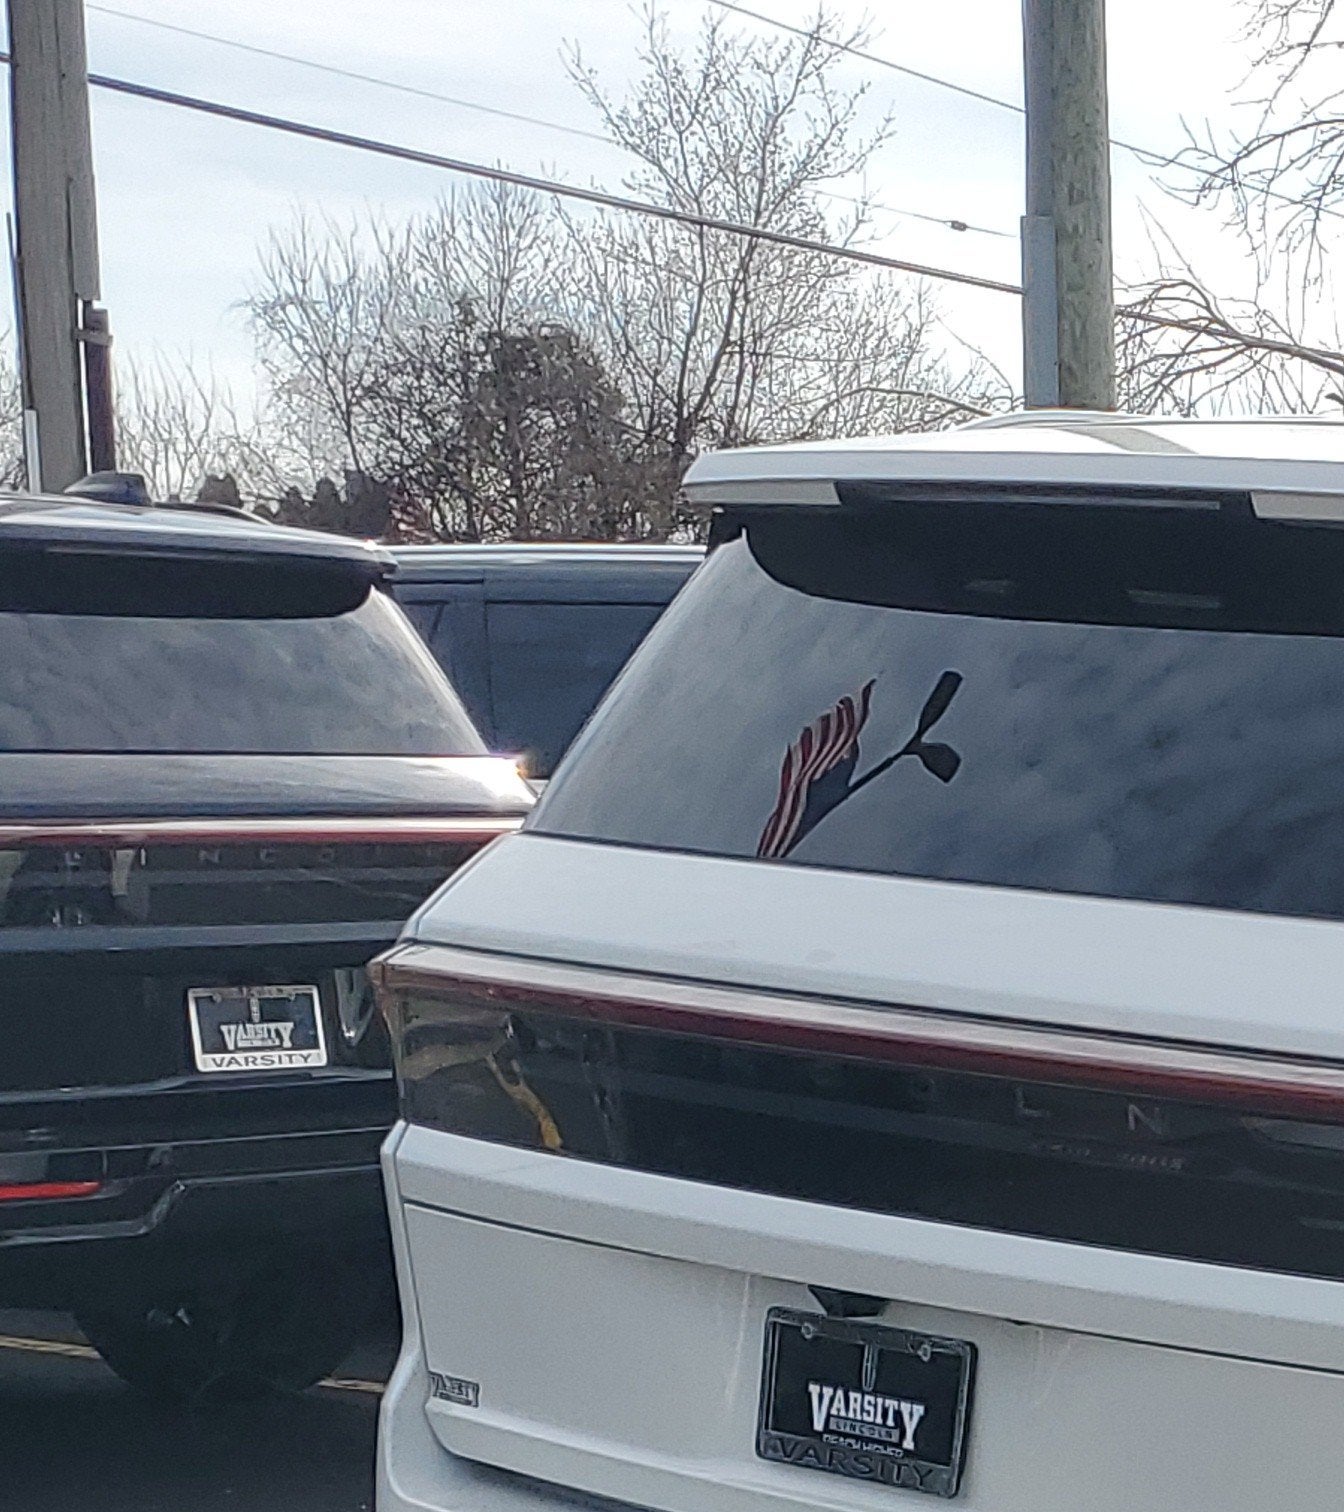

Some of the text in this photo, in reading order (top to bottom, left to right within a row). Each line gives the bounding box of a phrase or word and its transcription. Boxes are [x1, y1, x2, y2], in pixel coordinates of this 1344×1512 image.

[219, 1021, 295, 1051] VARSITY
[211, 1052, 313, 1068] VARSITY
[808, 1382, 926, 1451] VARSITY
[834, 1419, 894, 1440] LINCOLN
[777, 1437, 934, 1488] VARSITY
